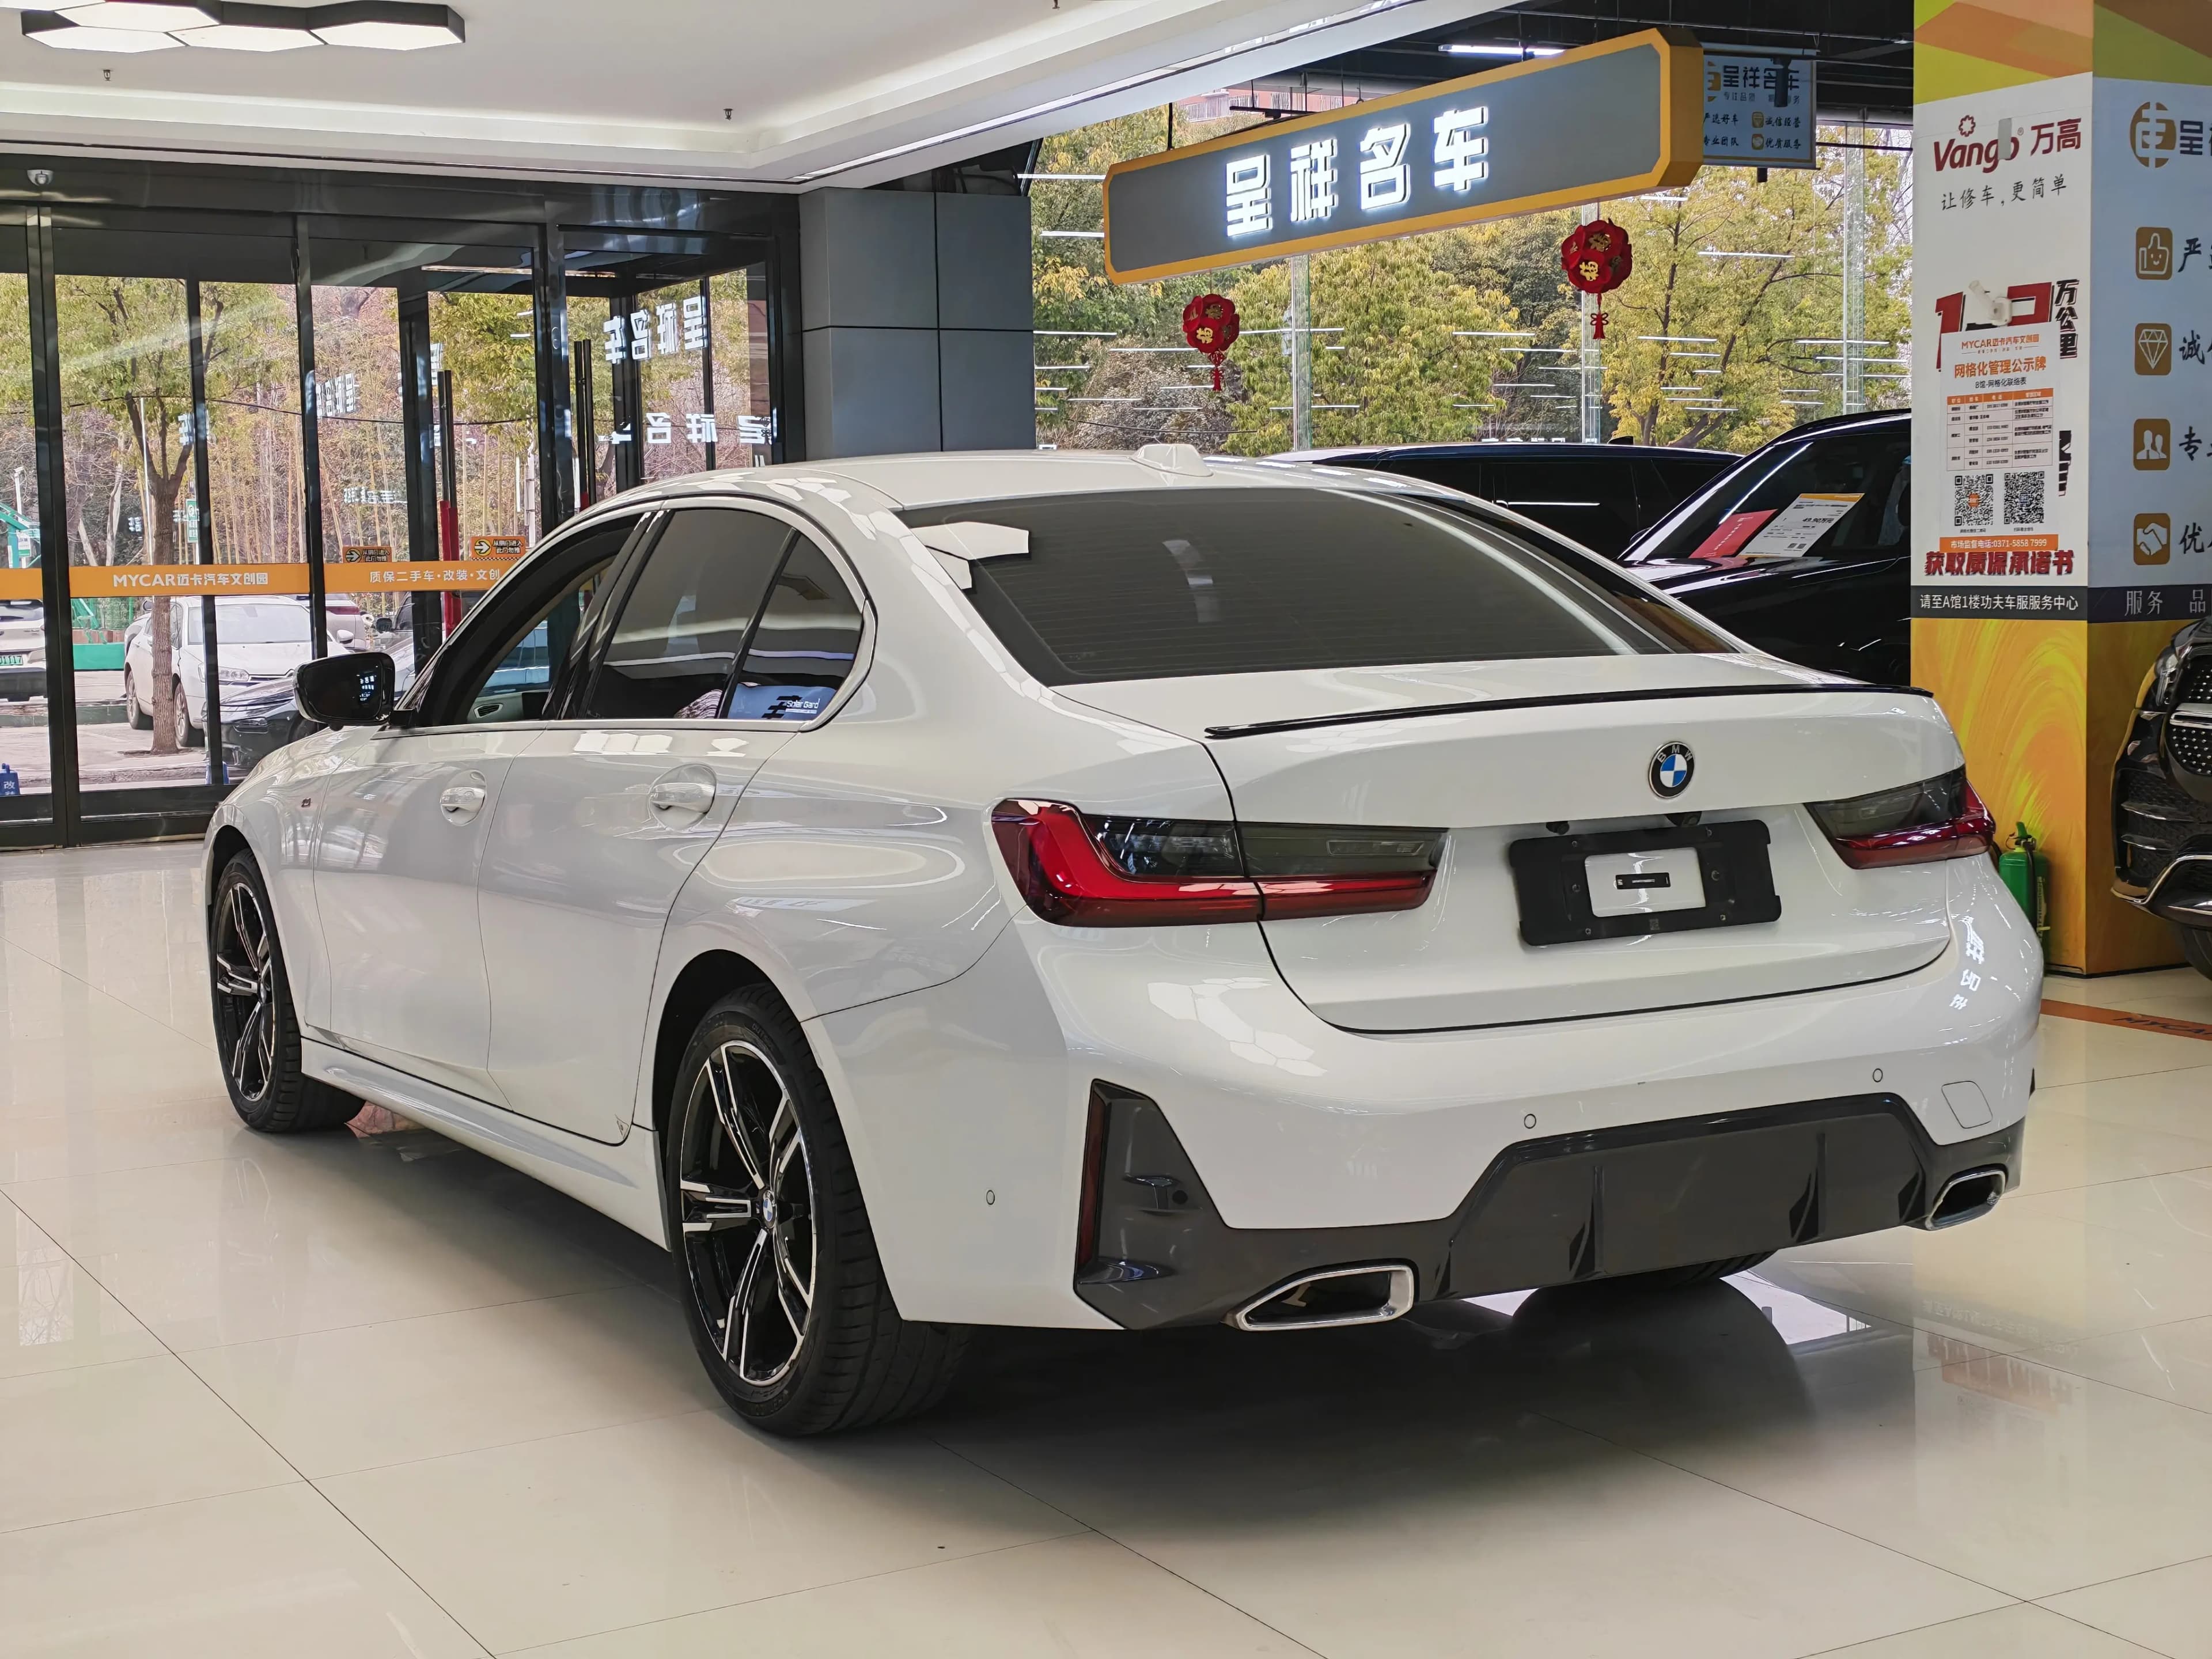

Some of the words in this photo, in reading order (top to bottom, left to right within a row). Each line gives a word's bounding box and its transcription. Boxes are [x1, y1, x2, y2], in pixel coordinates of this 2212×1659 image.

[2031, 118, 2081, 156] 万高
[2180, 120, 2212, 156] 呈
[1226, 106, 1488, 237] 呈祥名车
[2178, 237, 2212, 272] 严
[2054, 279, 2080, 359] 万公里
[2179, 329, 2212, 365] 诚
[1954, 356, 2047, 378] 网格化管理公示牌
[2179, 426, 2212, 461] 专
[2179, 522, 2212, 554] 优
[113, 573, 268, 587] MYCAR迈卡汽车文创园
[1920, 594, 2079, 611] 请至A馆1楼功夫车服服务中心
[2124, 590, 2163, 616] 服务
[2190, 589, 2212, 613] 品
[1657, 745, 1693, 763] BMW
[2112, 1017, 2212, 1035] MYCA
